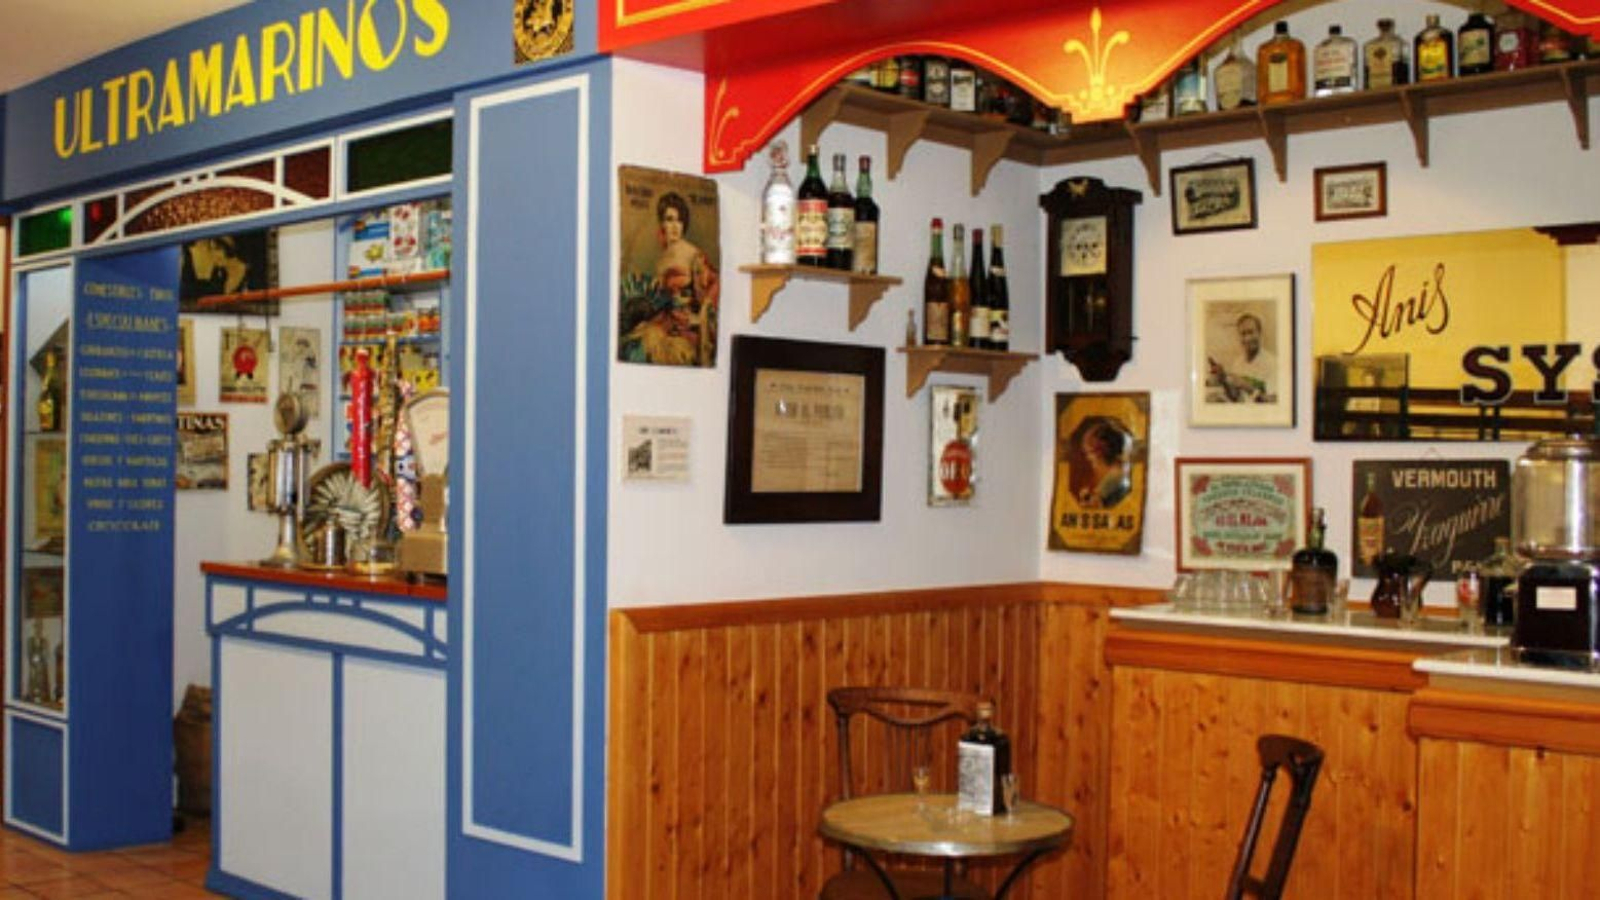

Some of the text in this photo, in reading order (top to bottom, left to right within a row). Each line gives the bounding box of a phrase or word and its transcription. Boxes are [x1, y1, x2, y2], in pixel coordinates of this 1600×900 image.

[54, 0, 450, 158] ULTRAMARINOS
[1342, 262, 1449, 355] Anis
[1391, 468, 1497, 488] VERMOUTH
